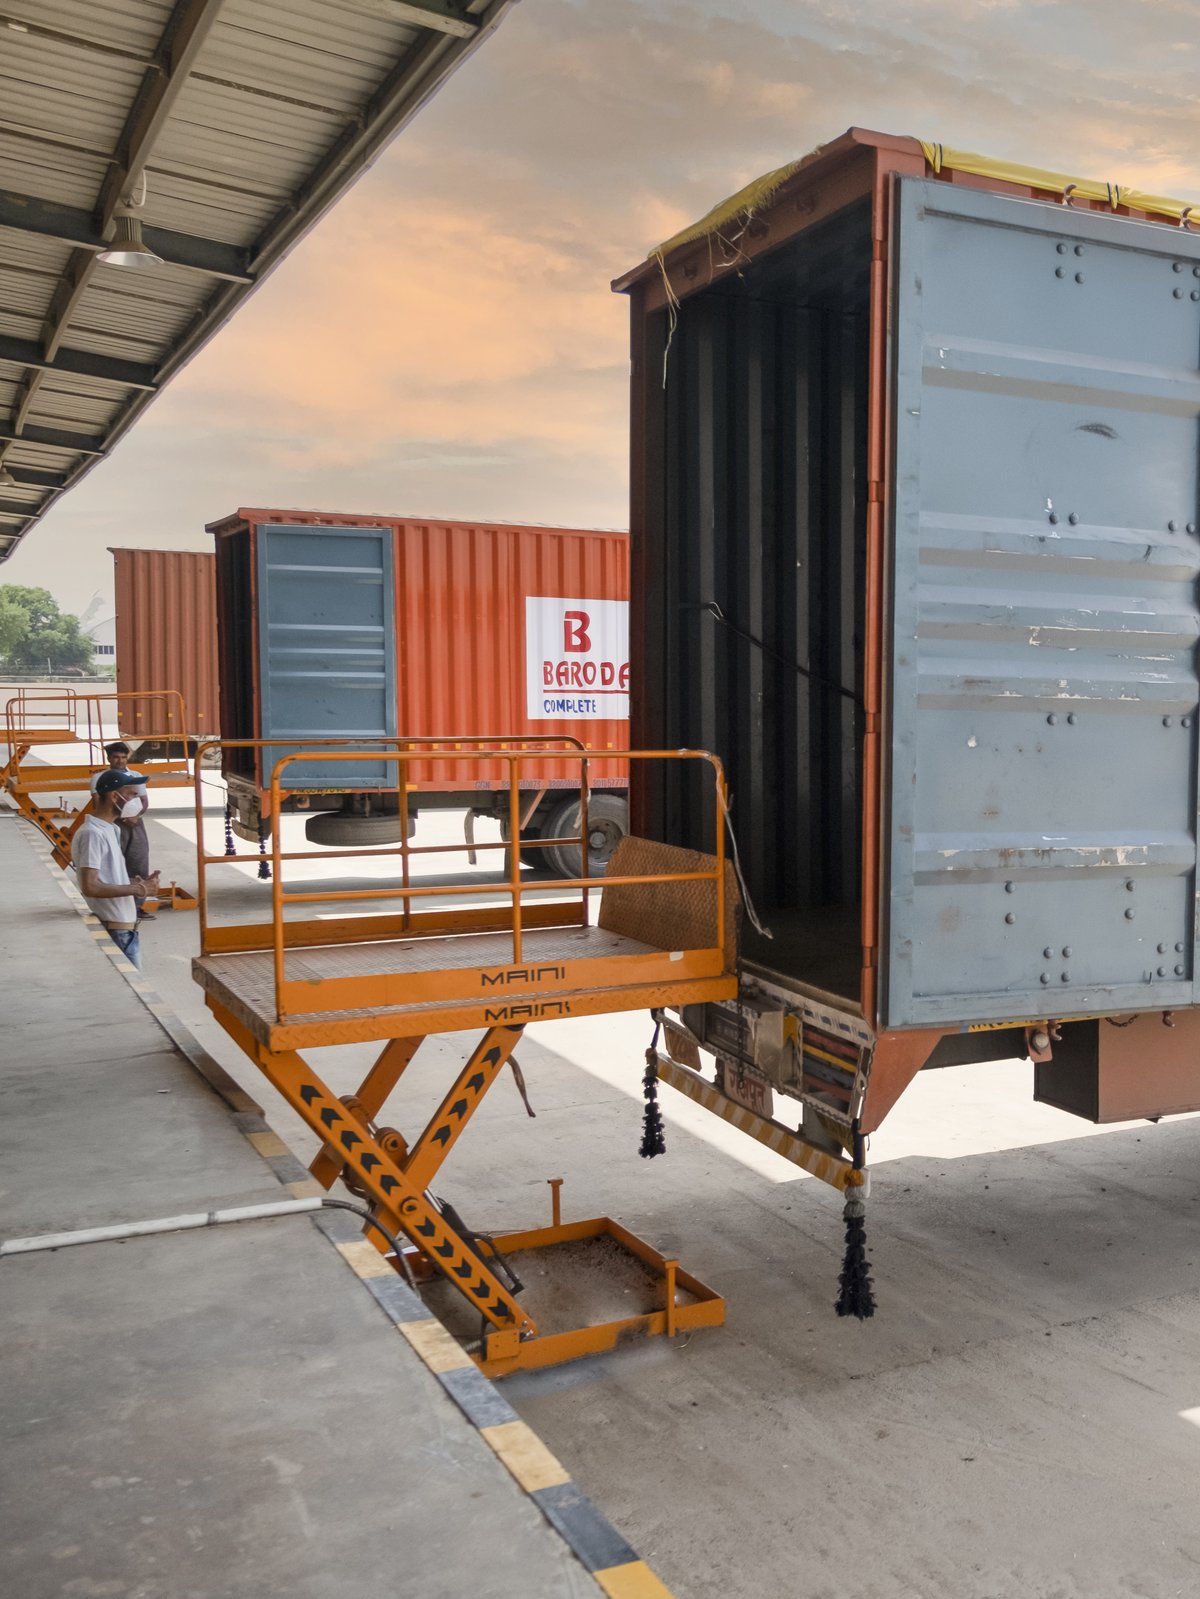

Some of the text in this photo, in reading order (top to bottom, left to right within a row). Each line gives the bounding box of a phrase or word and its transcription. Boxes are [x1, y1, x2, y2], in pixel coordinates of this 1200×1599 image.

[563, 611, 592, 653] B
[543, 699, 597, 713] COMPLETE
[481, 966, 565, 987] MAINI
